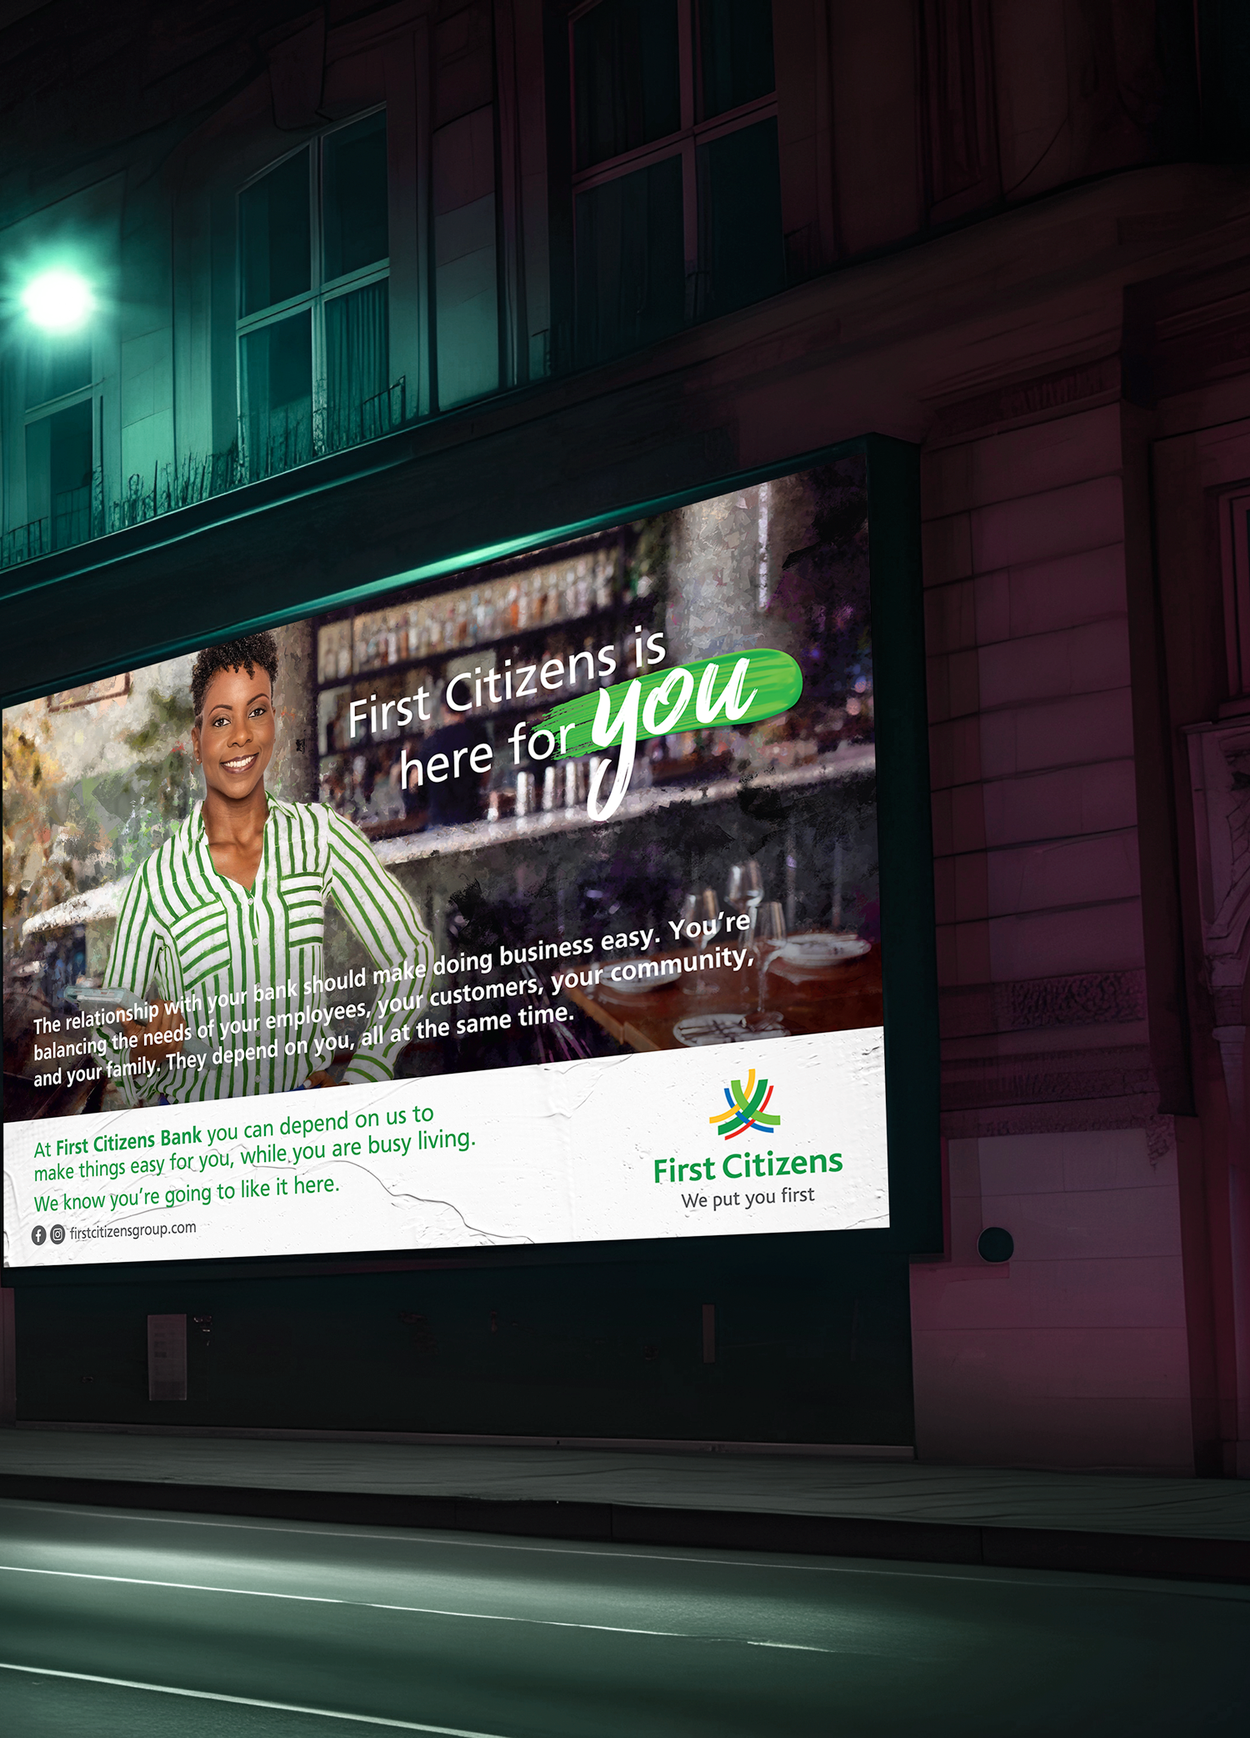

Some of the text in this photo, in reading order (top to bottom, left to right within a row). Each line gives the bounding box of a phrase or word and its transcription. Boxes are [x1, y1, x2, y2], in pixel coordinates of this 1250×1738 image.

[349, 624, 667, 738] First Citizens is
[401, 657, 758, 822] here for you
[33, 1017, 60, 1035] The
[66, 1002, 159, 1030] relationship
[165, 994, 201, 1015] with
[207, 989, 248, 1014] your
[254, 979, 297, 1002] bank
[304, 968, 366, 995] should
[374, 961, 426, 985] make
[433, 952, 493, 976] doing
[500, 938, 593, 966] business
[601, 927, 660, 950] easy.
[34, 947, 754, 1061] balancing the needs of your employees, your customers, your community,
[33, 1006, 574, 1088] and your family. They depend on you, all at the same time.
[34, 1106, 433, 1158] At First Citizens Bank you can depend on us to
[34, 1129, 476, 1181] make things easy for you, while you are busy living.
[654, 1150, 843, 1183] First Citizens
[34, 1195, 58, 1212] We
[64, 1193, 105, 1210] know
[165, 1185, 211, 1208] going
[217, 1184, 235, 1199] to
[241, 1179, 270, 1198] like
[276, 1177, 287, 1195] it
[294, 1176, 339, 1194] here.
[681, 1187, 815, 1211] We put you first
[70, 1222, 196, 1239] firstcitizensgroup.com
